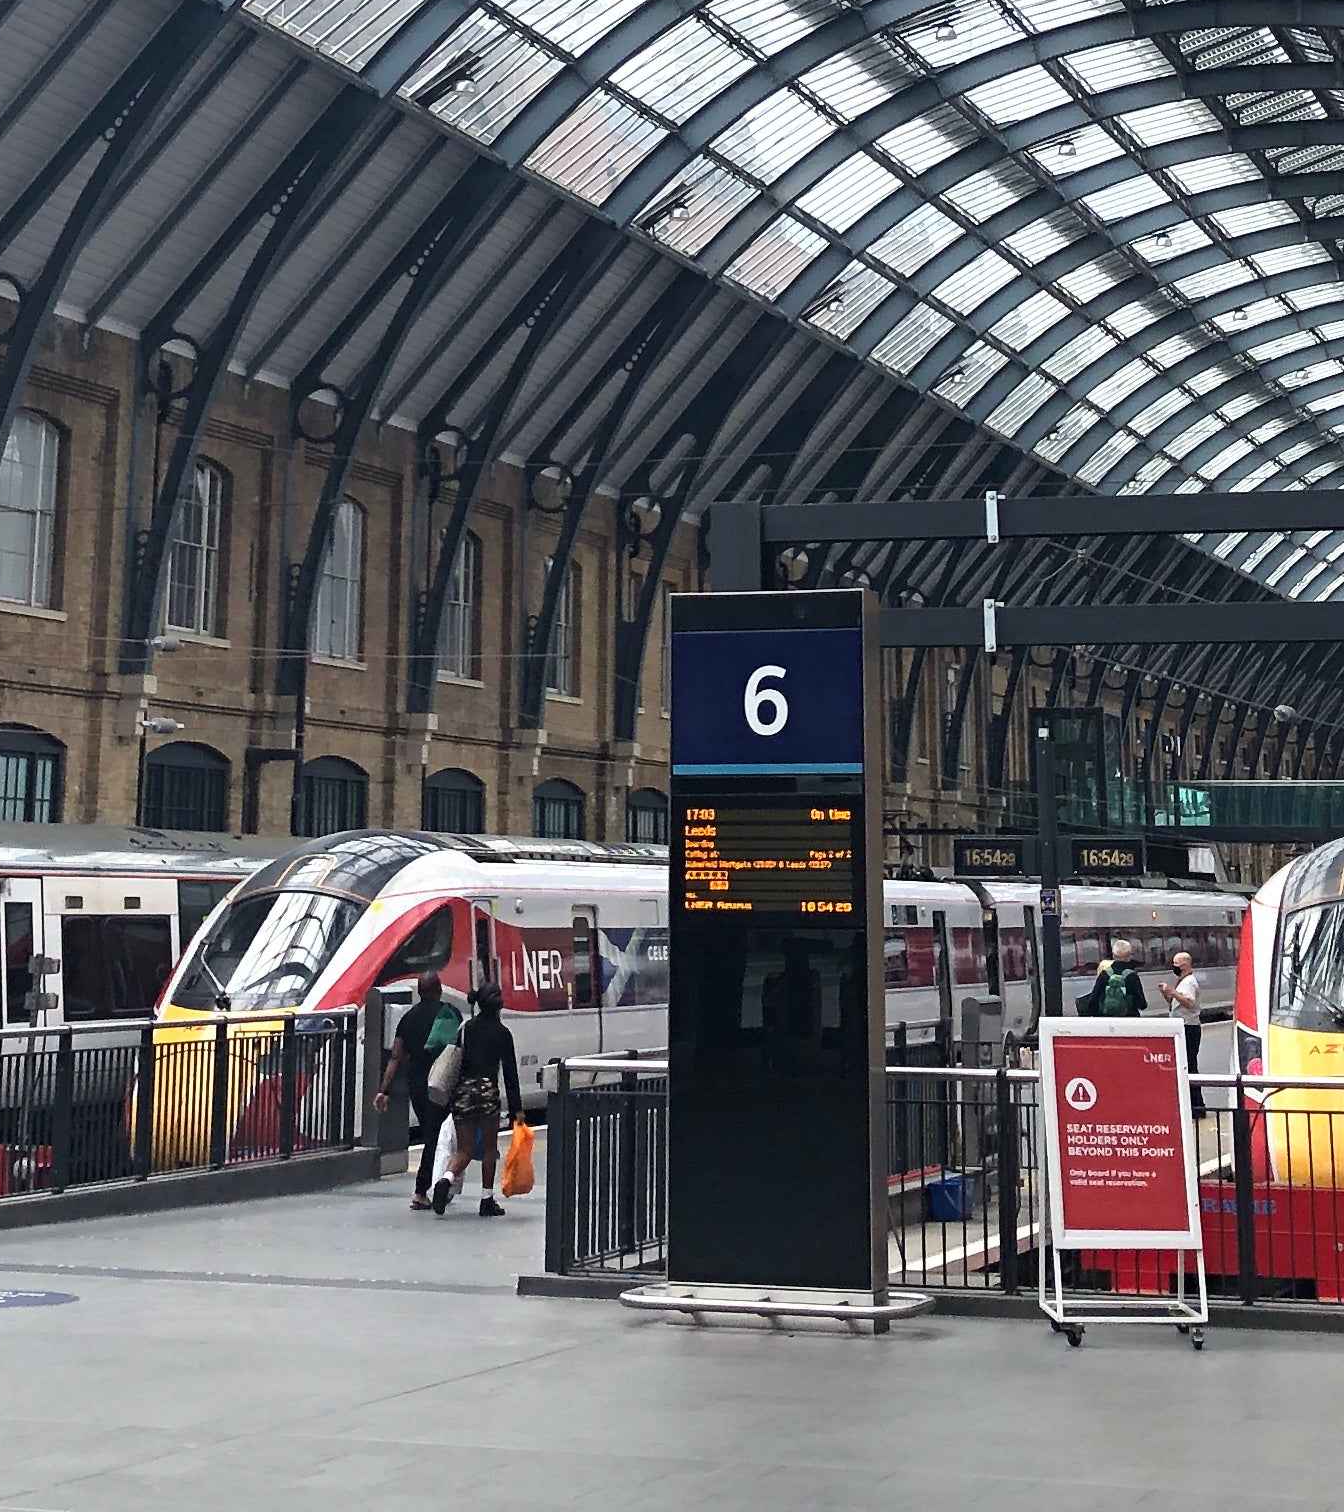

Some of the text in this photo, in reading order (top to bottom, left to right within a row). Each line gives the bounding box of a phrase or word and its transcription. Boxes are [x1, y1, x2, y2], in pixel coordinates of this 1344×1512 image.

[744, 665, 788, 736] 6
[810, 809, 824, 821] On
[685, 824, 716, 836] Leeds
[511, 941, 563, 998] LNER
[1143, 1052, 1172, 1063] LNER
[1066, 1123, 1170, 1135] SEAT RESERVATION
[1067, 1136, 1149, 1146] HOLDERS ONLY
[1068, 1147, 1175, 1157] BEYOND THIS POINT
[1069, 1169, 1087, 1177] Only
[1088, 1169, 1110, 1177] board
